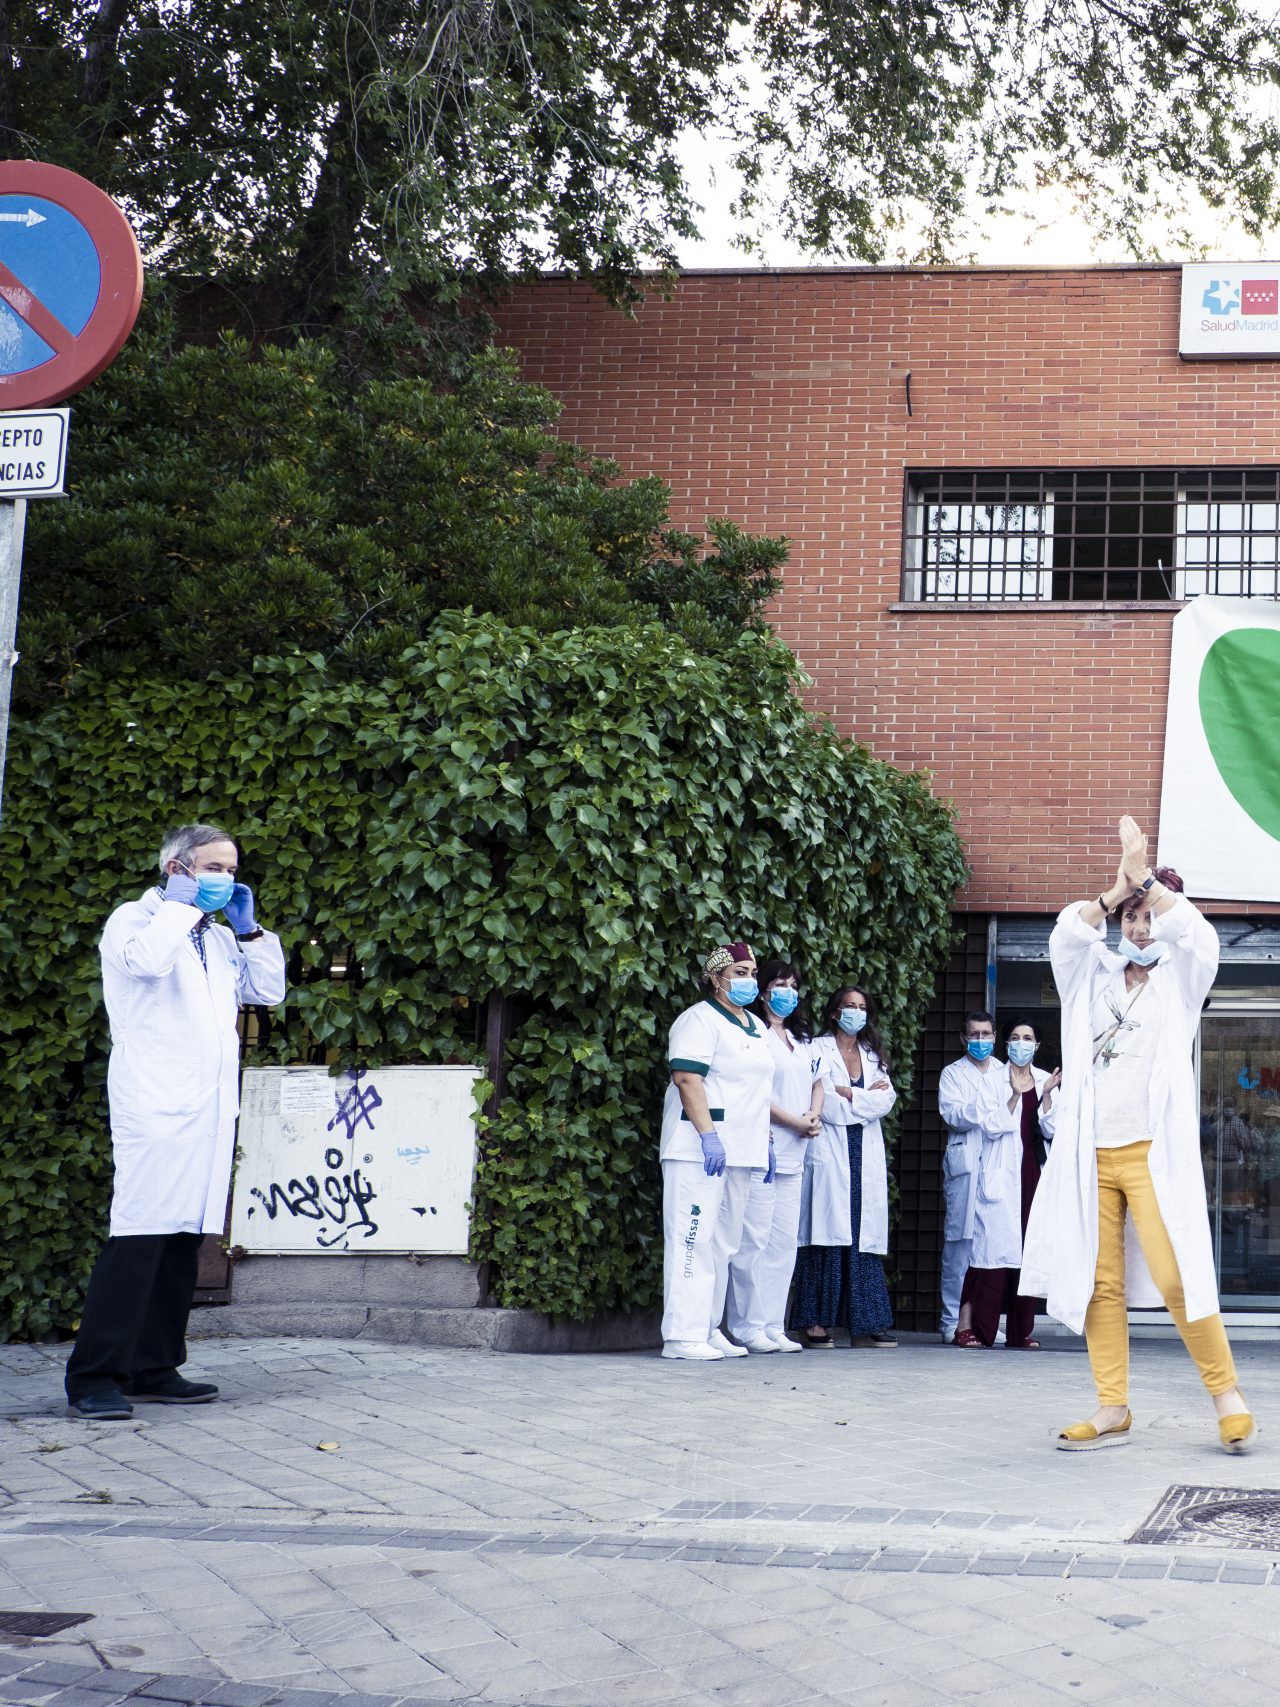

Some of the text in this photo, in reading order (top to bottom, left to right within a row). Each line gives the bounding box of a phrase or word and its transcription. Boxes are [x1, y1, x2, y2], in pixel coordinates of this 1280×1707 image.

[1200, 319, 1279, 333] SaludMadrid
[0, 429, 43, 447] EPTO
[683, 1218, 699, 1279] grupofissa
